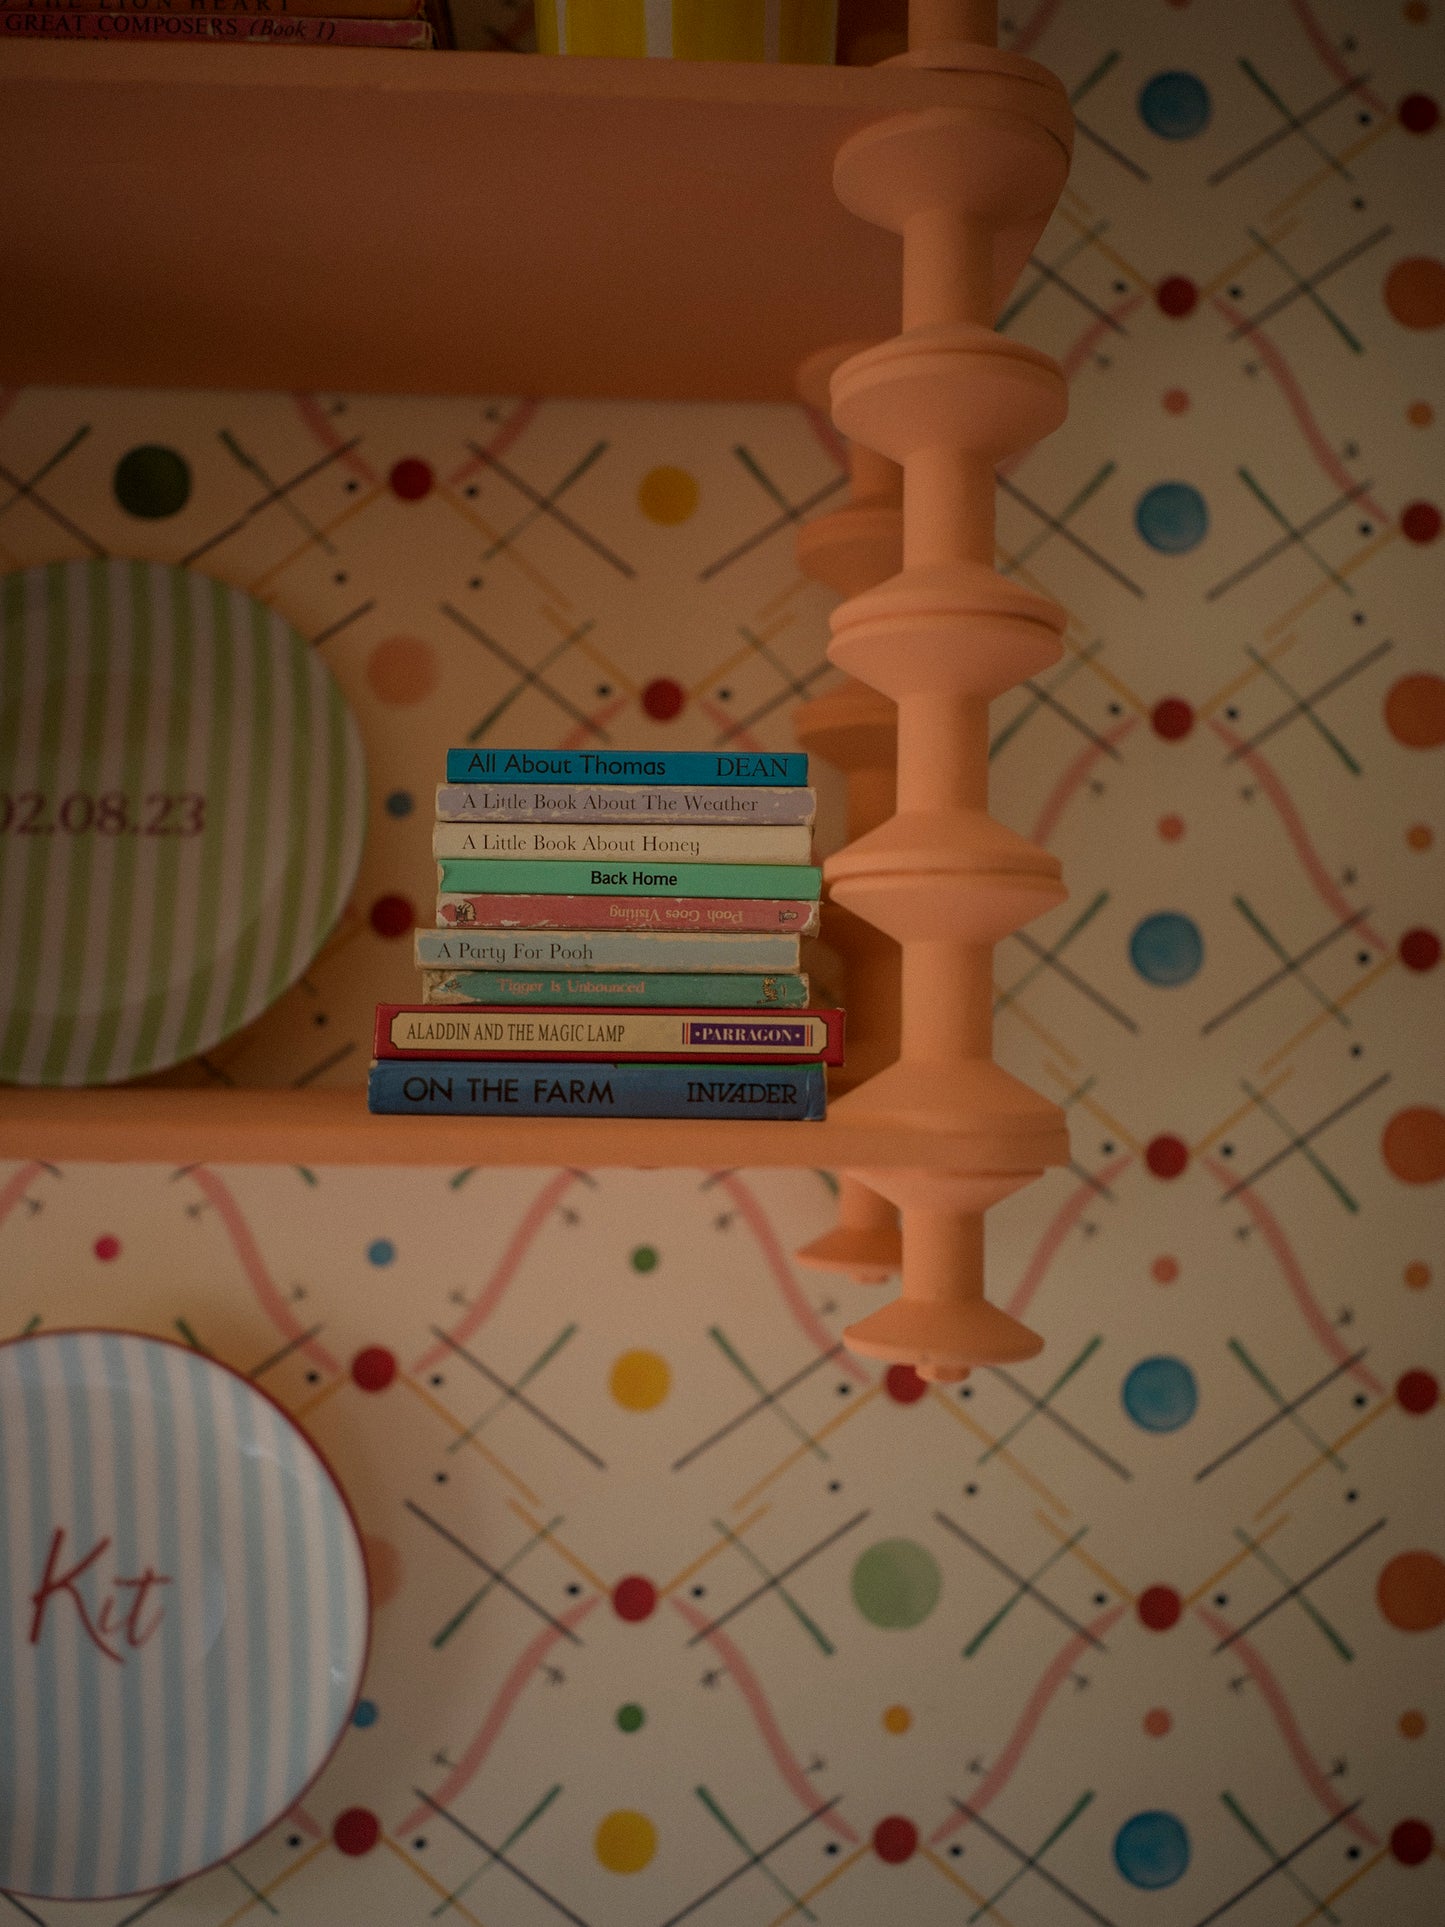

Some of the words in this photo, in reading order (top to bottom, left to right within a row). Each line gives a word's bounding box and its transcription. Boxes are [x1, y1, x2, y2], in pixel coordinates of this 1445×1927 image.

[5, 13, 86, 32] GREAT
[98, 15, 238, 36] COMPOSERS
[249, 19, 306, 37] (Book
[467, 753, 496, 773] All
[504, 754, 572, 775] About
[579, 754, 666, 776] Thomas
[715, 756, 789, 778] DEAN
[462, 793, 477, 809] A
[483, 792, 527, 810] Little
[534, 793, 577, 810] Book
[583, 794, 637, 811] About
[642, 794, 677, 811] The
[684, 795, 759, 812] Weather
[462, 834, 477, 850] A
[483, 834, 527, 850] Little
[534, 834, 577, 851] Book
[582, 835, 636, 852] About
[642, 835, 700, 856] Honey
[591, 870, 628, 886] Back
[632, 871, 678, 887] Home
[610, 904, 662, 923] Visiting
[666, 908, 700, 923] Goes
[707, 909, 744, 925] Pooh
[437, 942, 452, 959] A
[459, 942, 506, 963] Party
[513, 942, 547, 960] For
[551, 943, 594, 960] Pooh
[496, 977, 544, 996] Tigger
[567, 979, 646, 994] Unbounced
[406, 1022, 471, 1041] ALADDIN
[474, 1023, 503, 1042] AND
[508, 1023, 535, 1042] THE
[538, 1024, 585, 1042] MAGIC
[587, 1024, 626, 1043] LAMP
[403, 1076, 453, 1103] ON
[467, 1077, 519, 1103] THE
[534, 1078, 616, 1105] FARM
[687, 1081, 798, 1105] INVADER
[29, 1527, 173, 1664] Kit
